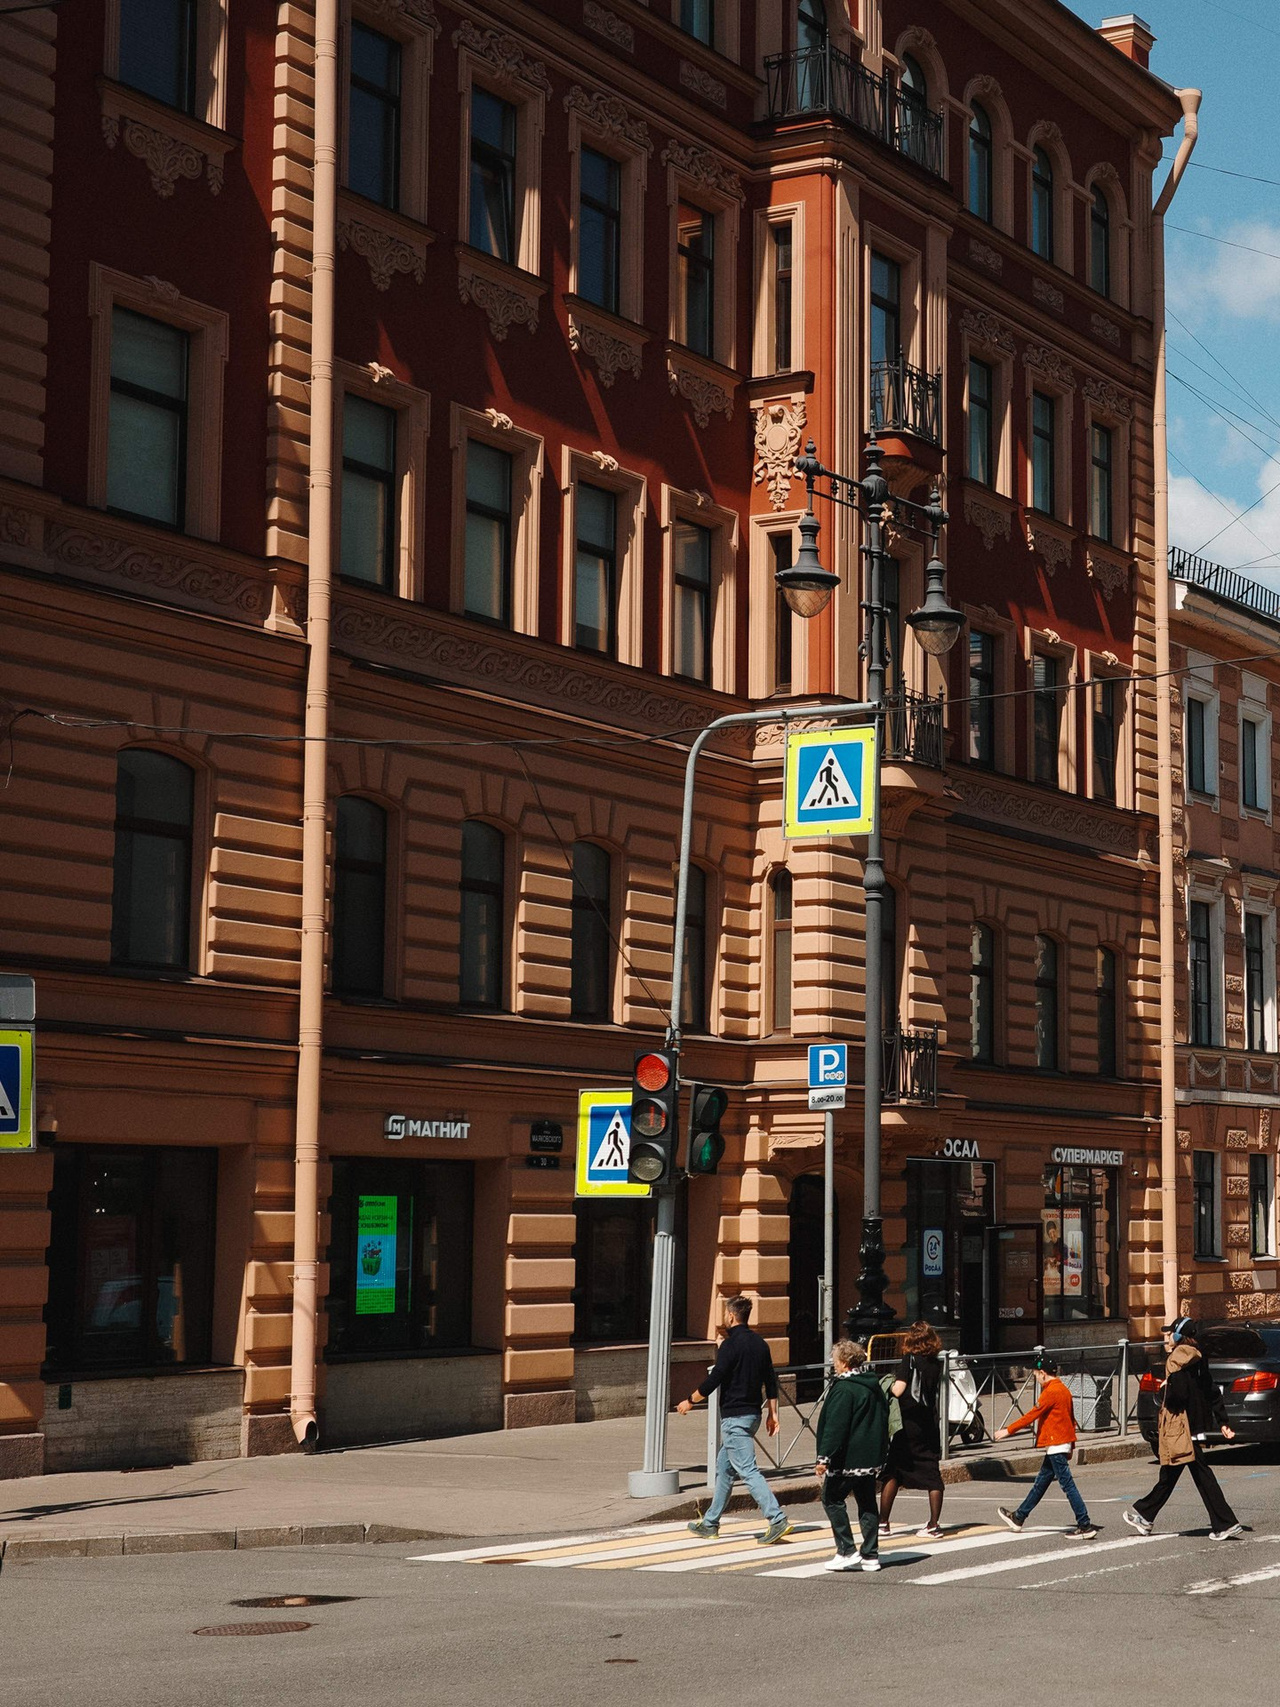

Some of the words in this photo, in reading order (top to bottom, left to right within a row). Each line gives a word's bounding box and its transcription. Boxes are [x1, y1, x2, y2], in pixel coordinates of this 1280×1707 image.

[819, 1049, 839, 1082] P
[811, 1095, 843, 1104] 8.00-20.00
[409, 1120, 471, 1139] МАГНИТ
[935, 1138, 980, 1159] ОСАЛ
[1053, 1147, 1124, 1165] СУПЕРМАРКЕТ
[930, 1242, 937, 1251] 24
